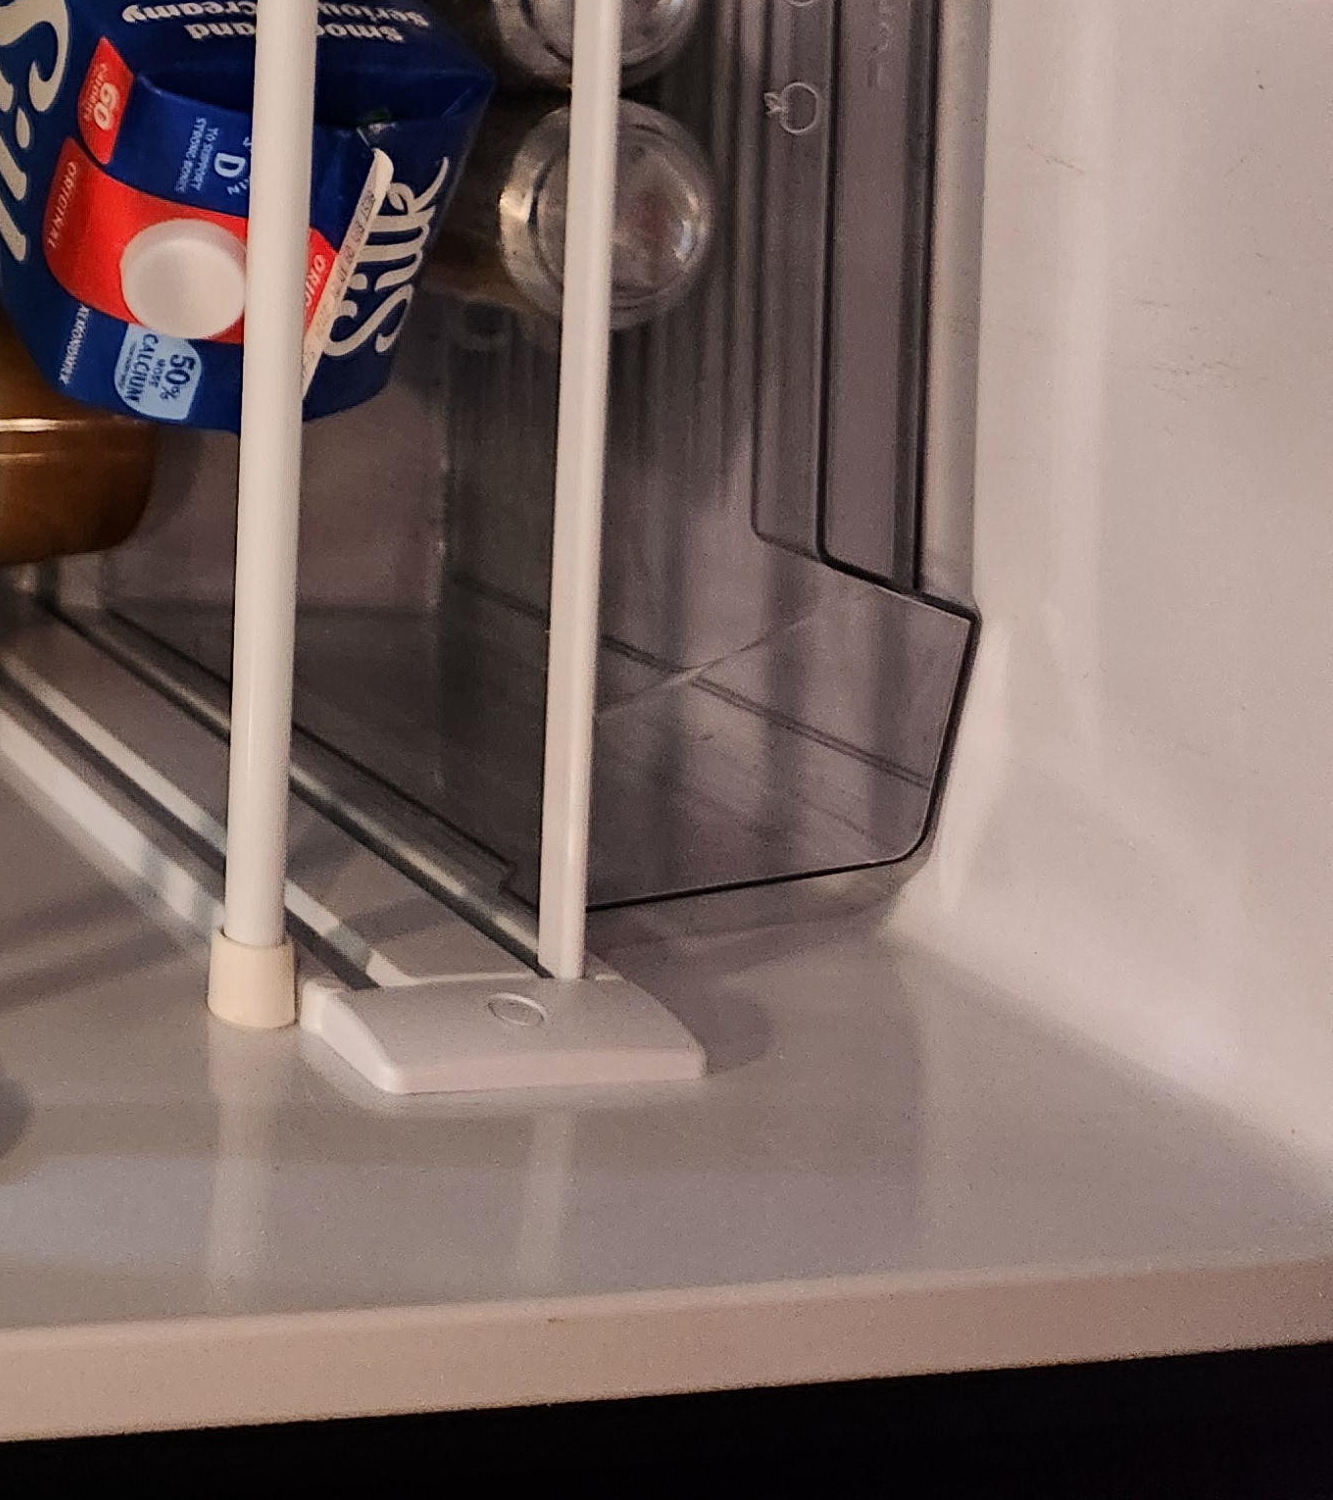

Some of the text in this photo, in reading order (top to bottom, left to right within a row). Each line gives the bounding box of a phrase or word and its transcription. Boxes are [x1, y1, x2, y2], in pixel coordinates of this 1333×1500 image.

[122, 0, 429, 28] Seriou Creamy
[184, 21, 256, 40] and
[94, 83, 120, 131] 60
[186, 117, 207, 159] STRONG
[190, 143, 213, 190] SUPPORT
[214, 153, 246, 177] D
[48, 161, 77, 248] ORIGINAL
[323, 157, 449, 356] Silk
[127, 333, 159, 401] CALCIUM
[159, 352, 195, 400] 50%
